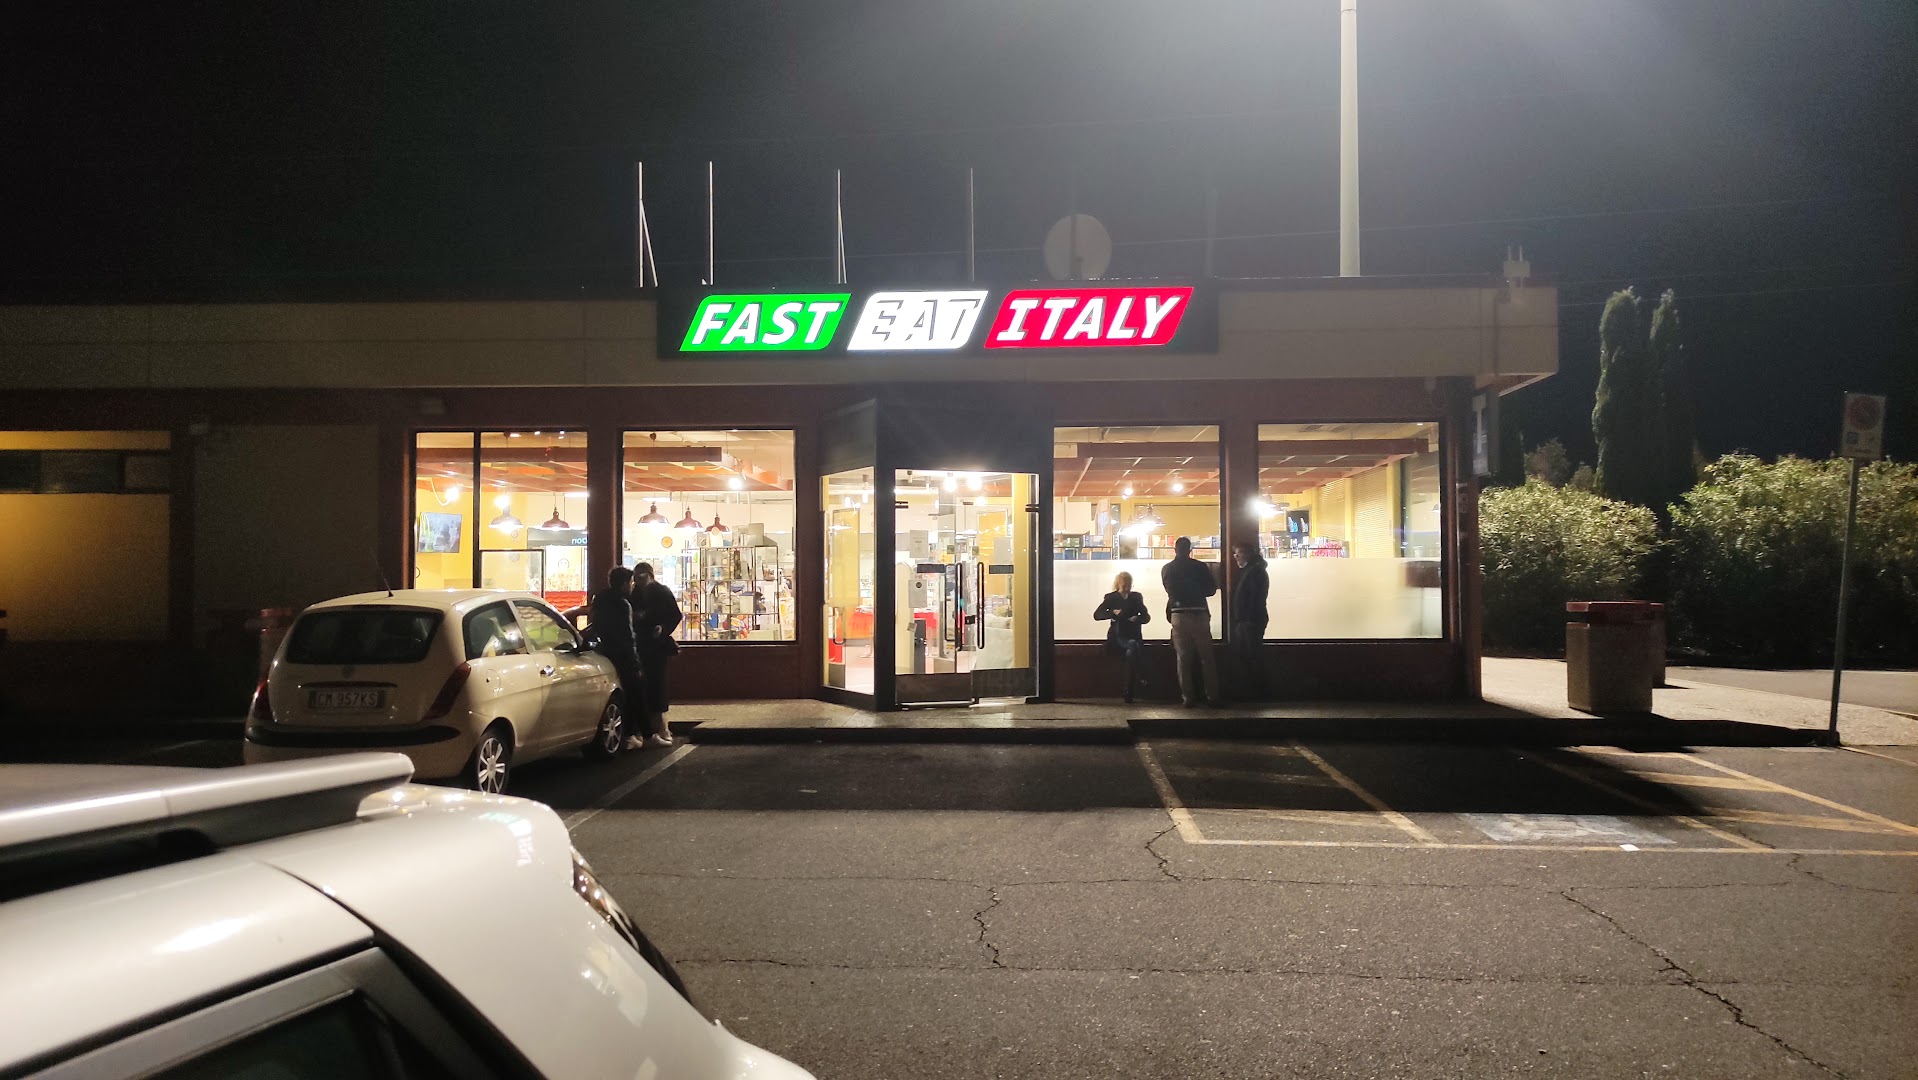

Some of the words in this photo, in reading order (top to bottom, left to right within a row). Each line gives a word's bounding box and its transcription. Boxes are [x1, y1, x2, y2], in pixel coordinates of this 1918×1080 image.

[692, 301, 843, 345] FAST
[867, 299, 981, 343] EAT
[997, 296, 1184, 341] ITALY
